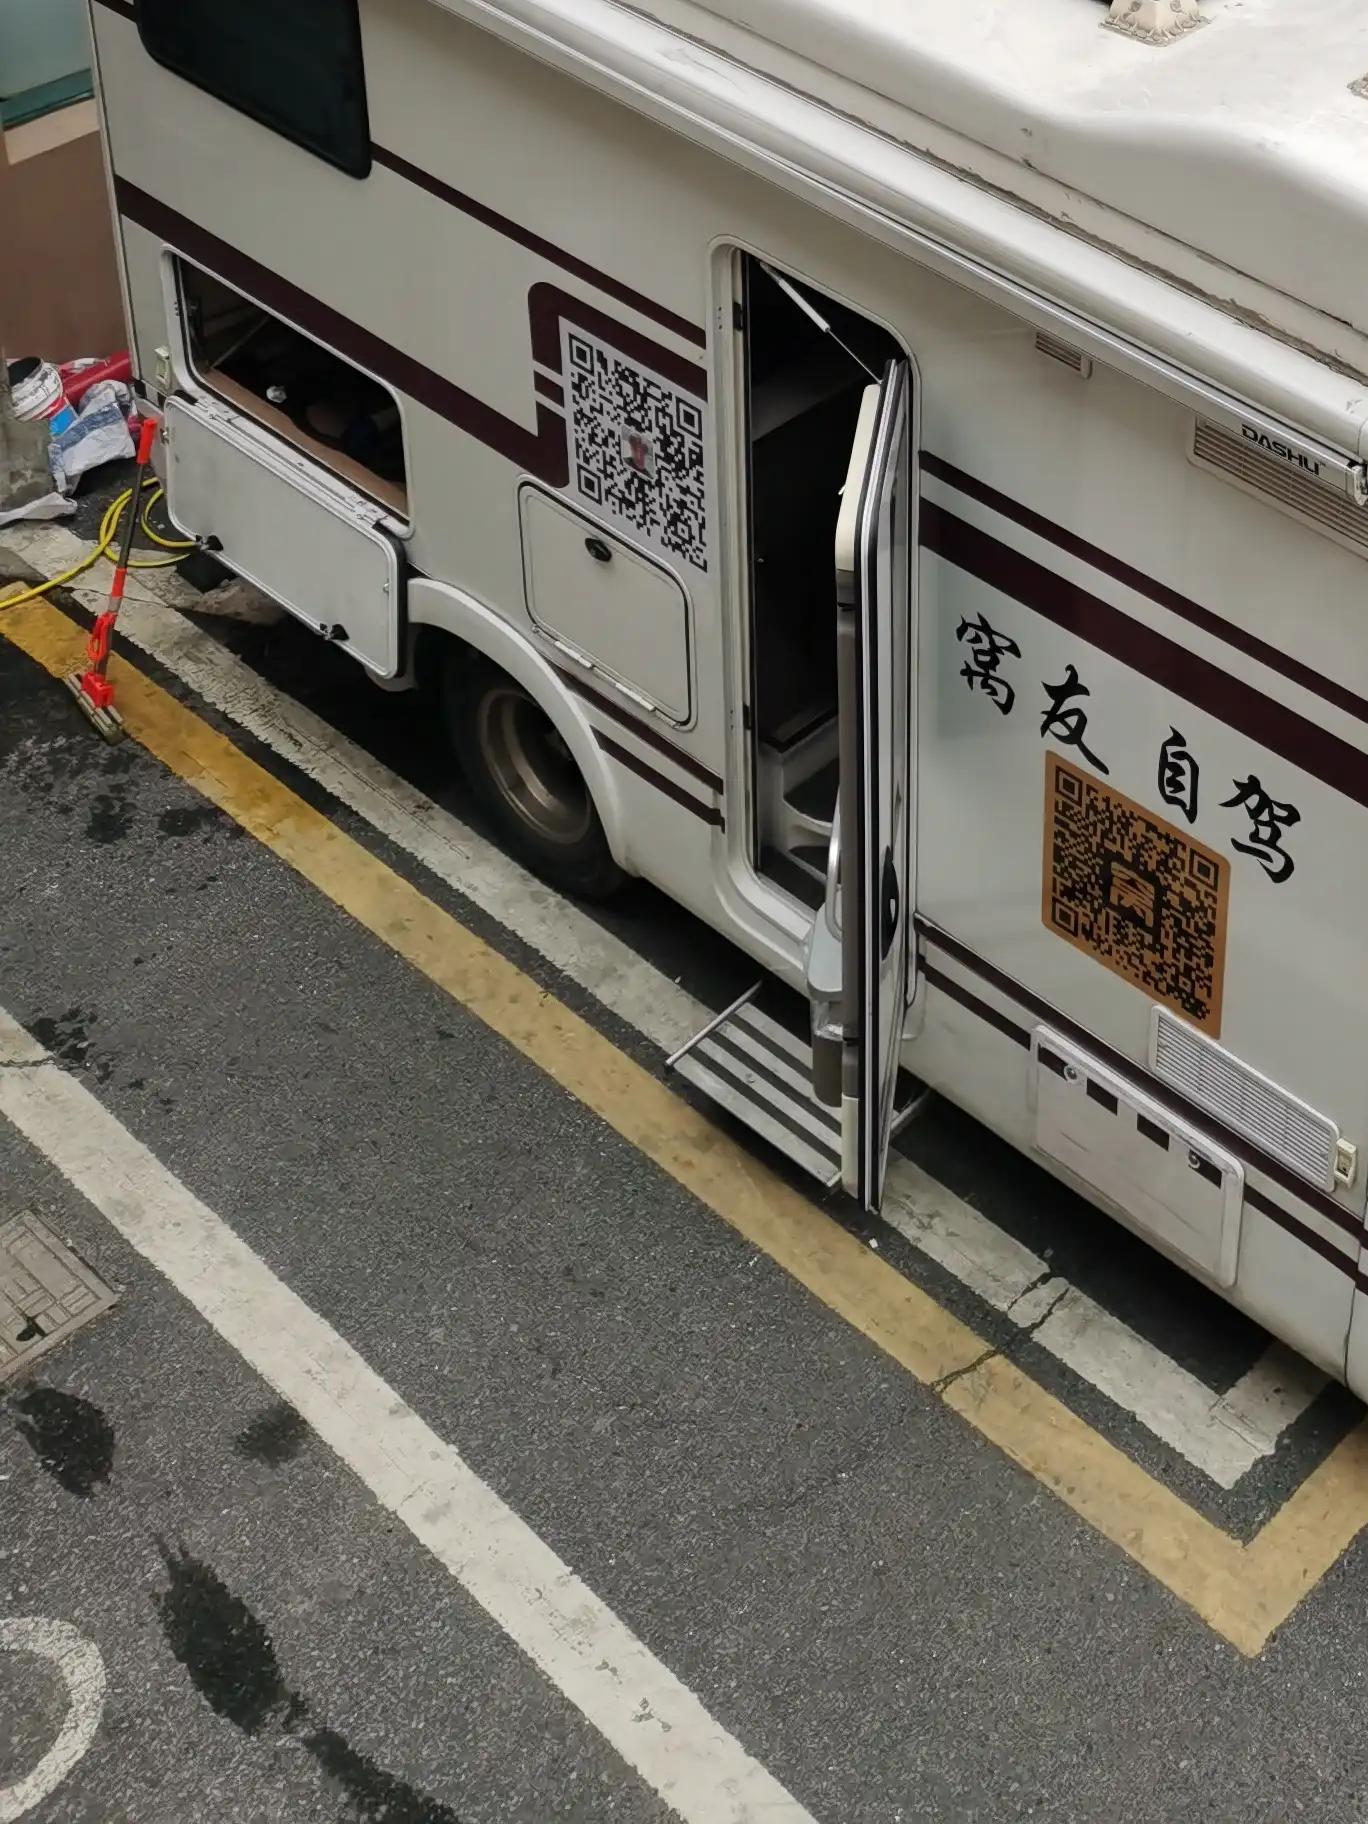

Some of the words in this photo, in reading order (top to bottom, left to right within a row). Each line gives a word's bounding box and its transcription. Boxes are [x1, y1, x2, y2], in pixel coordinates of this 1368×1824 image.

[1241, 423, 1320, 477] DASHU
[955, 610, 1302, 885] 窝友自驾
